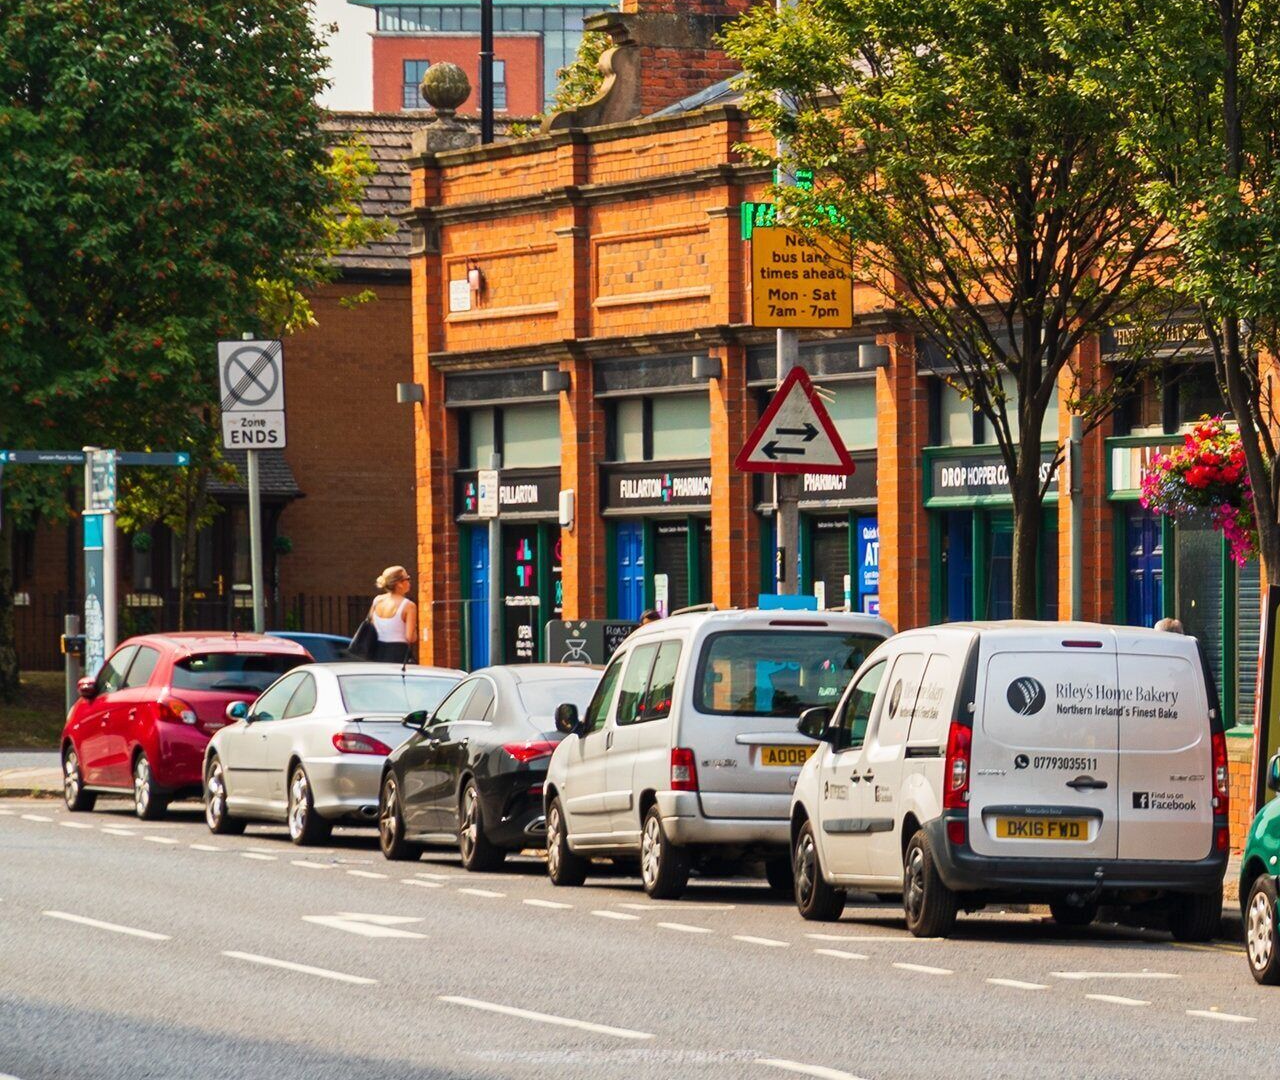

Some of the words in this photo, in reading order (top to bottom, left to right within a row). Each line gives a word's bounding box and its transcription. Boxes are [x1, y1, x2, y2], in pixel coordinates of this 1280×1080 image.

[772, 251, 798, 264] bus
[801, 251, 830, 264] lane
[760, 266, 799, 280] times
[802, 266, 846, 280] ahead
[768, 288, 799, 302] Mon
[812, 288, 838, 302] Sat
[767, 305, 797, 318] 7am
[809, 305, 840, 319] 7pm
[241, 417, 266, 428] Zone
[230, 429, 278, 444] ENDS
[804, 473, 848, 492] PHARMACY
[941, 466, 967, 488] DROP
[967, 464, 997, 485] HOPPER
[499, 485, 538, 504] FULLARTON
[620, 478, 662, 498] FULLARTON
[673, 476, 713, 496] PHARMACY
[865, 541, 880, 567] AT
[1056, 683, 1094, 703] Riley's
[1096, 683, 1133, 700] Home
[1135, 685, 1179, 707] Bakery
[1056, 703, 1093, 716] Northern
[1132, 706, 1156, 718] Finest
[1158, 708, 1179, 720] Bake
[1033, 756, 1098, 771] 07793035511
[1151, 791, 1165, 800] Find
[1150, 799, 1197, 811] Facebook
[1007, 821, 1044, 837] DK16
[1047, 822, 1080, 838] FWD
